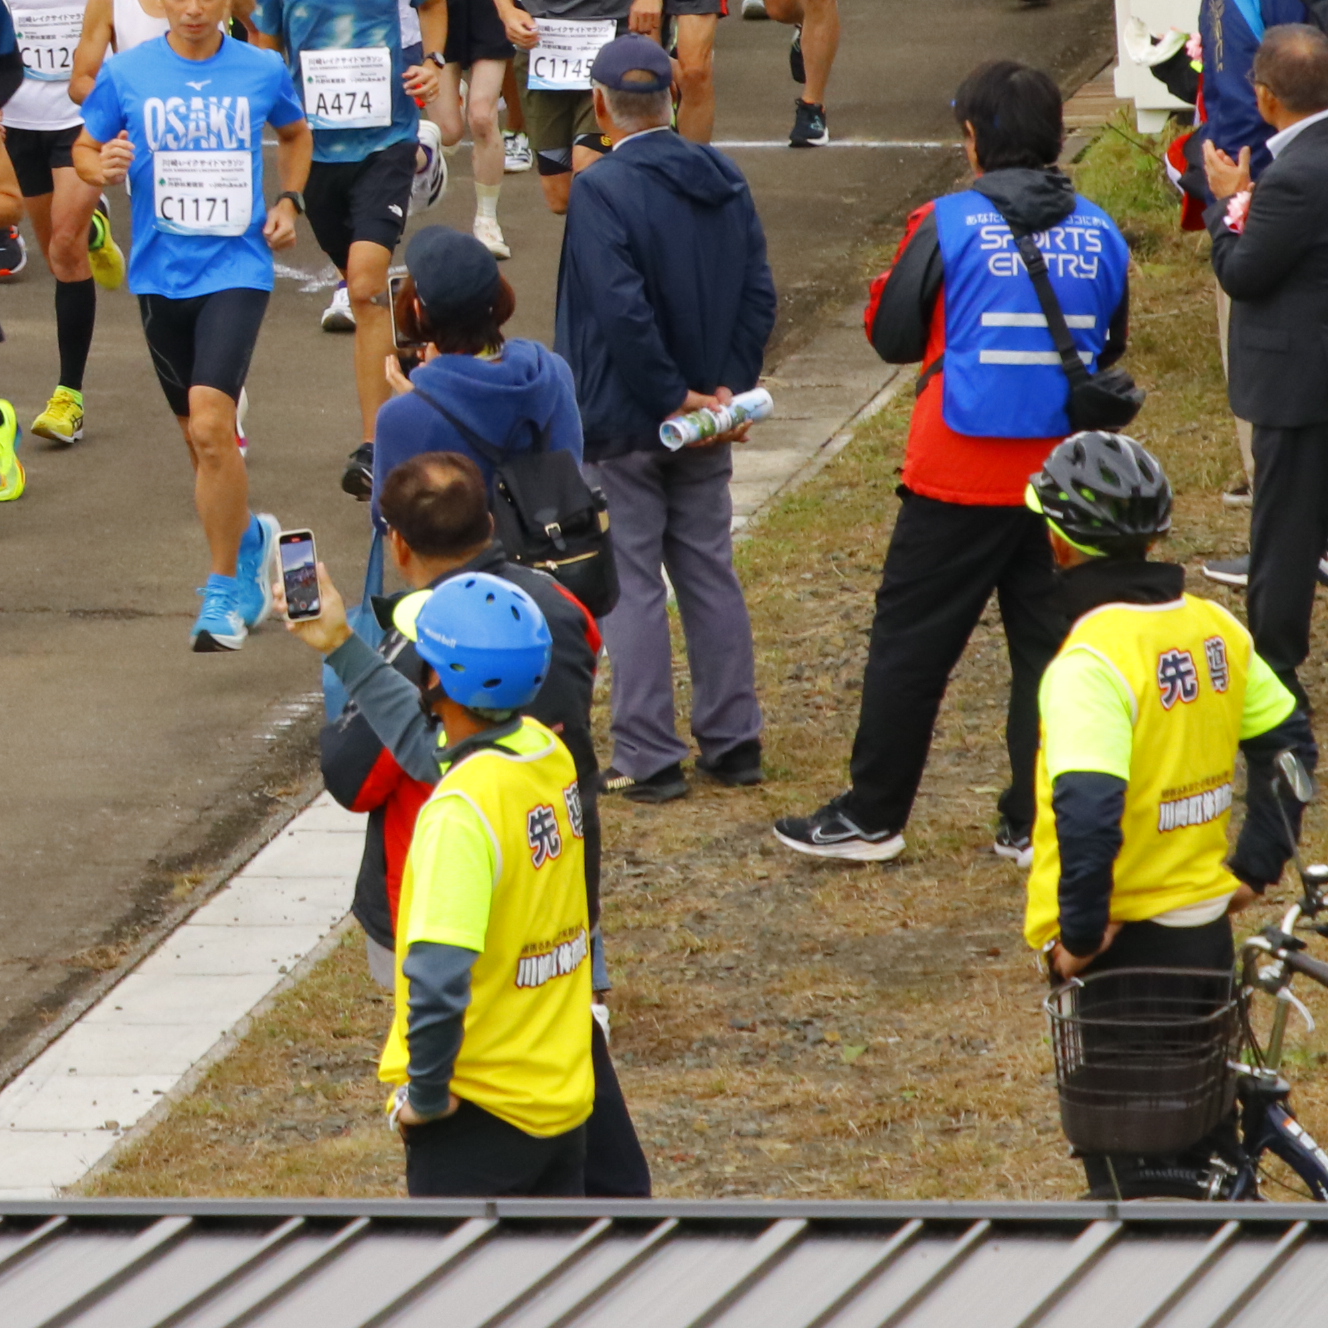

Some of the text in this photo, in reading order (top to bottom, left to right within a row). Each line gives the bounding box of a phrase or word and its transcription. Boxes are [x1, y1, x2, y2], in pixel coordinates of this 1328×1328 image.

[21, 47, 76, 68] C112
[315, 91, 373, 115] A474
[144, 96, 252, 152] OSAKA
[160, 196, 230, 221] C1171
[1158, 635, 1229, 711] 先導
